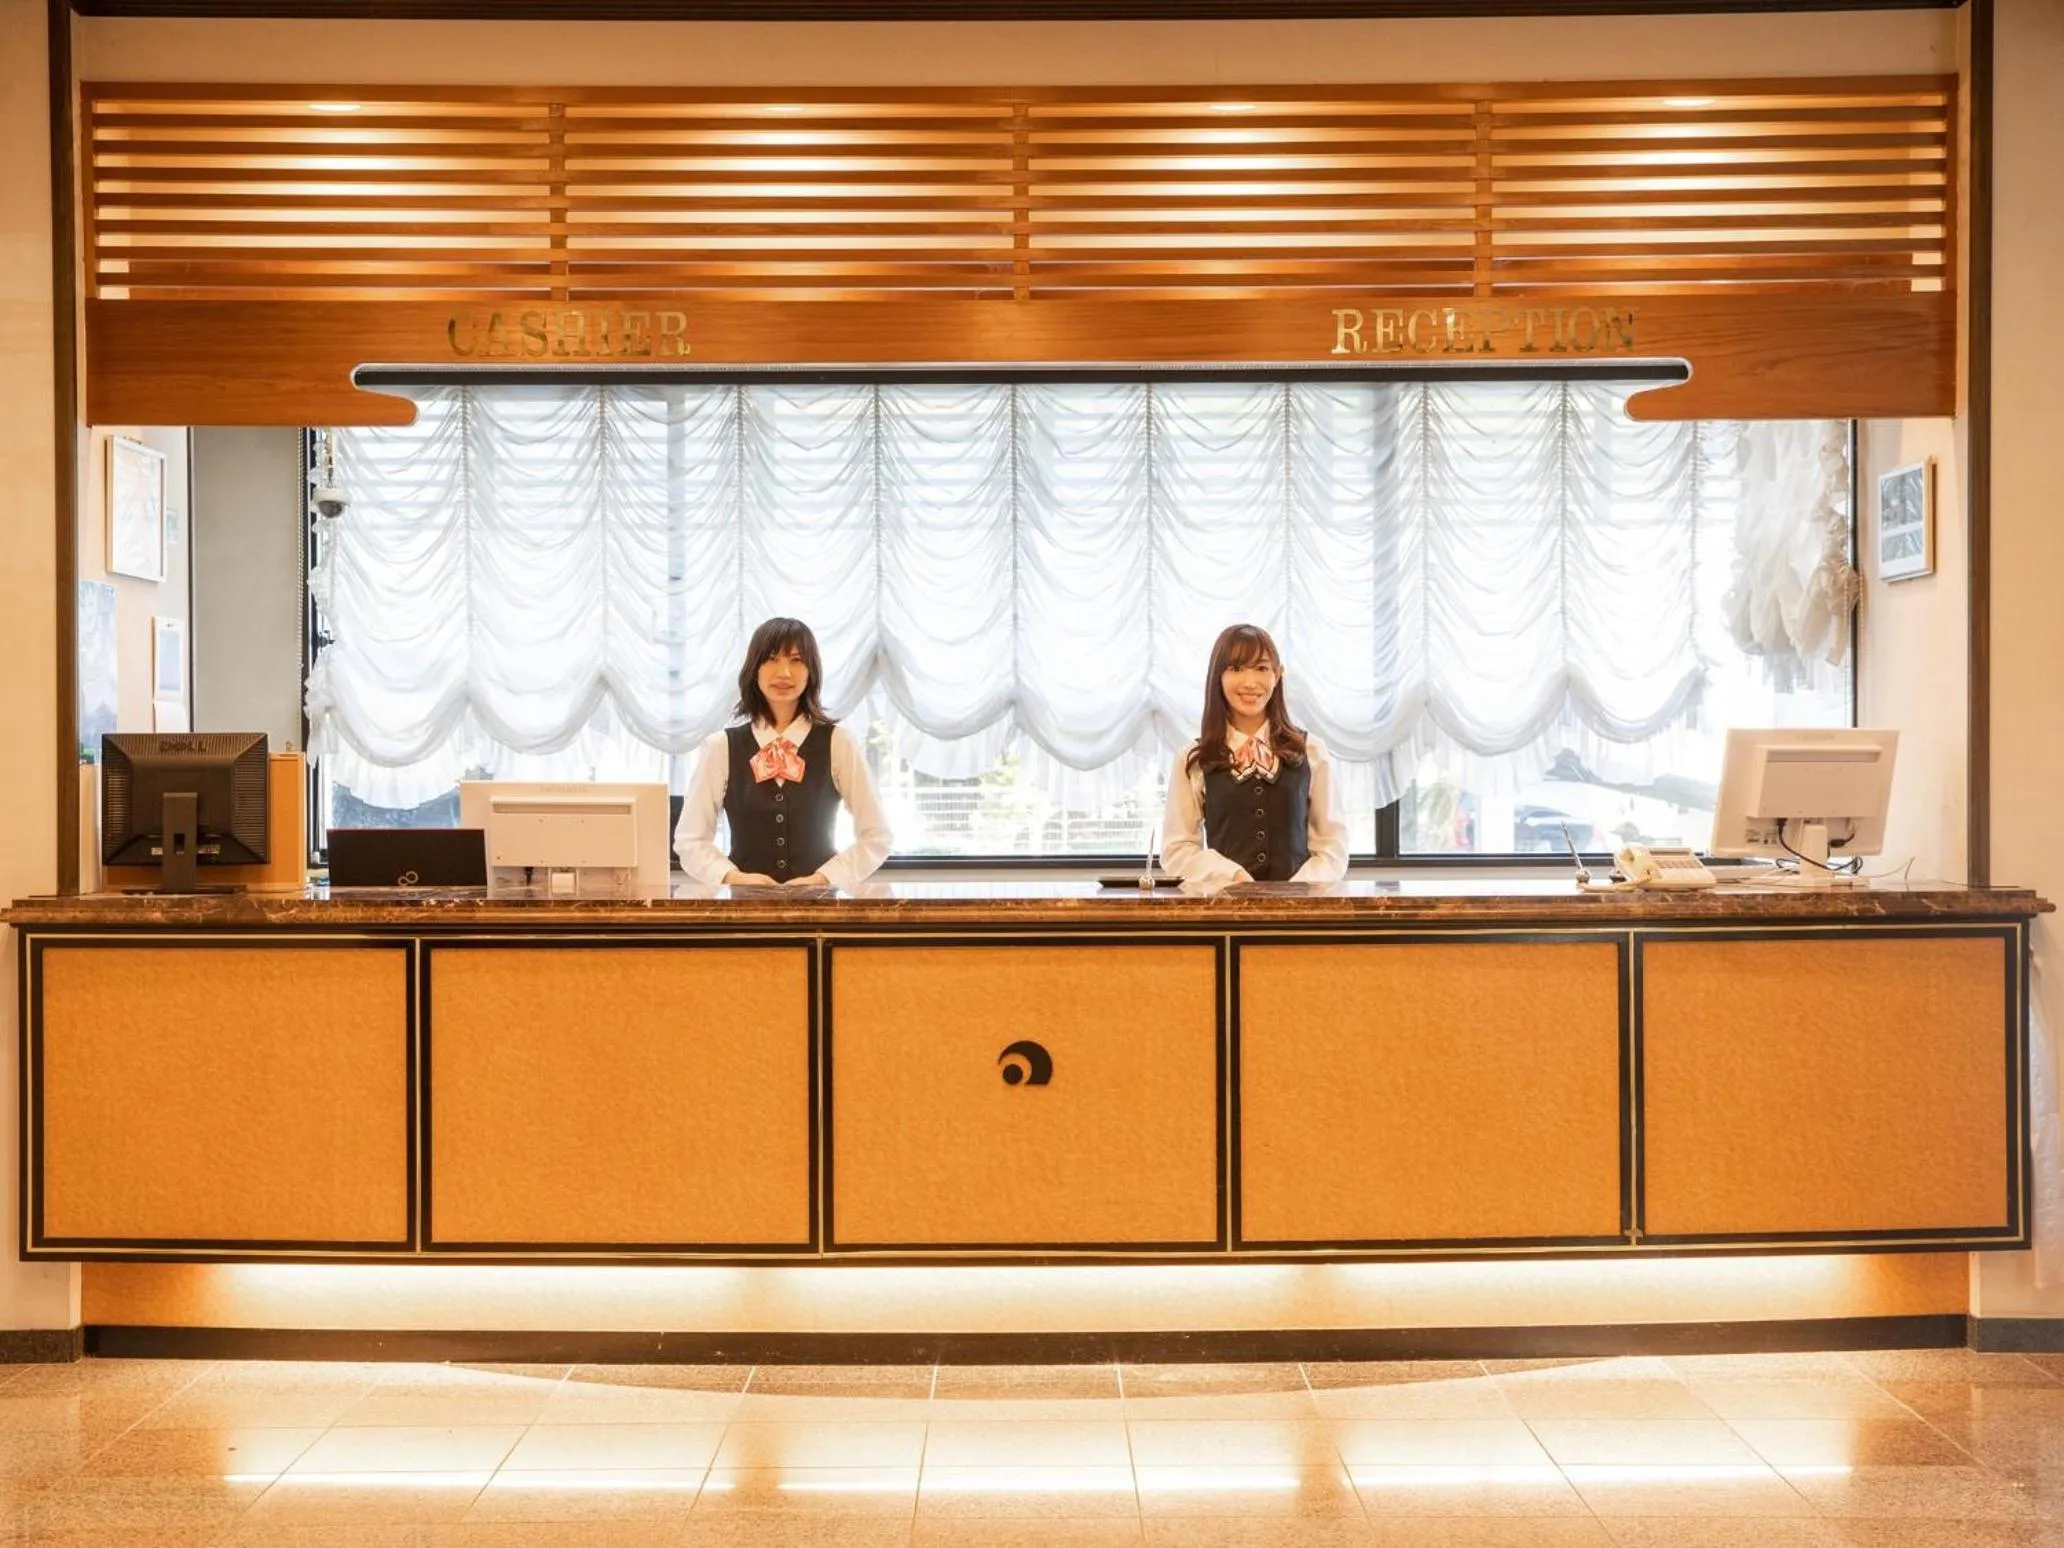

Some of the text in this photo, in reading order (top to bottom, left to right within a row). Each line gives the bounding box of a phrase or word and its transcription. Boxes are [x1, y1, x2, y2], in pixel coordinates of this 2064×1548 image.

[446, 310, 691, 357] CASHIER
[1331, 307, 1640, 355] RECEPTION
[160, 741, 206, 752] DELL
